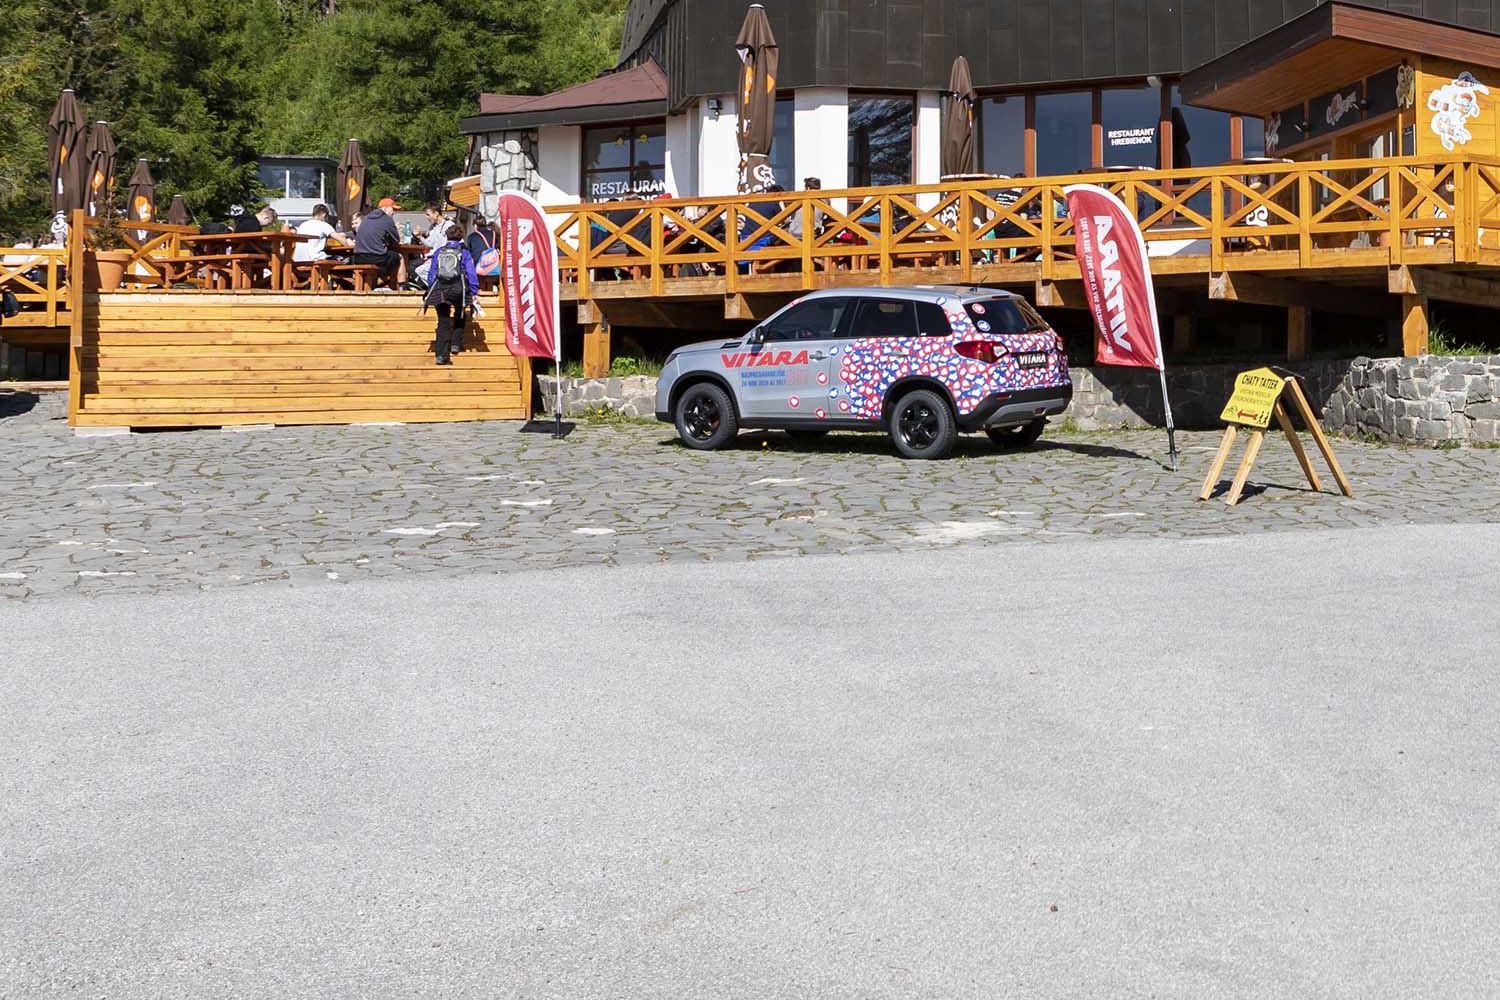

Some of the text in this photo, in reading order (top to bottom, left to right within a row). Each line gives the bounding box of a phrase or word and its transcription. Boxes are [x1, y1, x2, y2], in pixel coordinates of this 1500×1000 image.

[1108, 128, 1155, 138] RESTAURANT
[1111, 136, 1153, 146] HREBIENOK
[721, 350, 809, 368] VITARA
[1019, 353, 1046, 364] VITARA
[1241, 375, 1260, 387] CHATY
